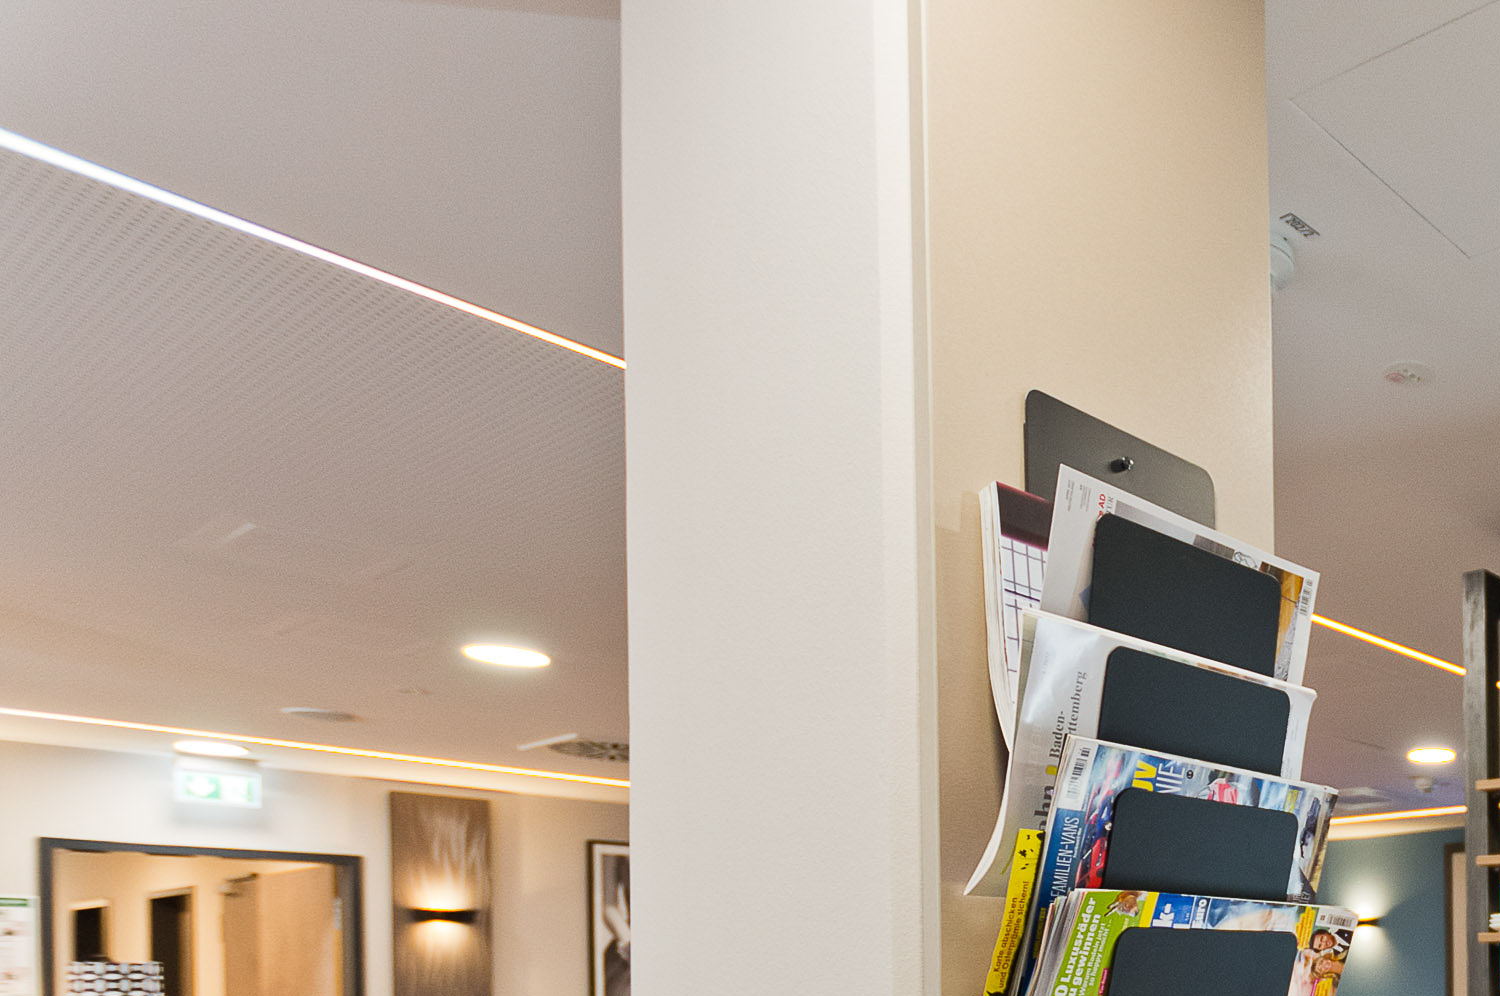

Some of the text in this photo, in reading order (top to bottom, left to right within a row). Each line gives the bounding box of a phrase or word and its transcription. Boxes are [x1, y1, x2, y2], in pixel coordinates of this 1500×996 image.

[1051, 817, 1079, 896] FAMILIEN-VANS
[1001, 897, 1018, 948] abschicken
[1061, 897, 1096, 983] Luxusräder
[1073, 914, 1101, 986] gewinnen
